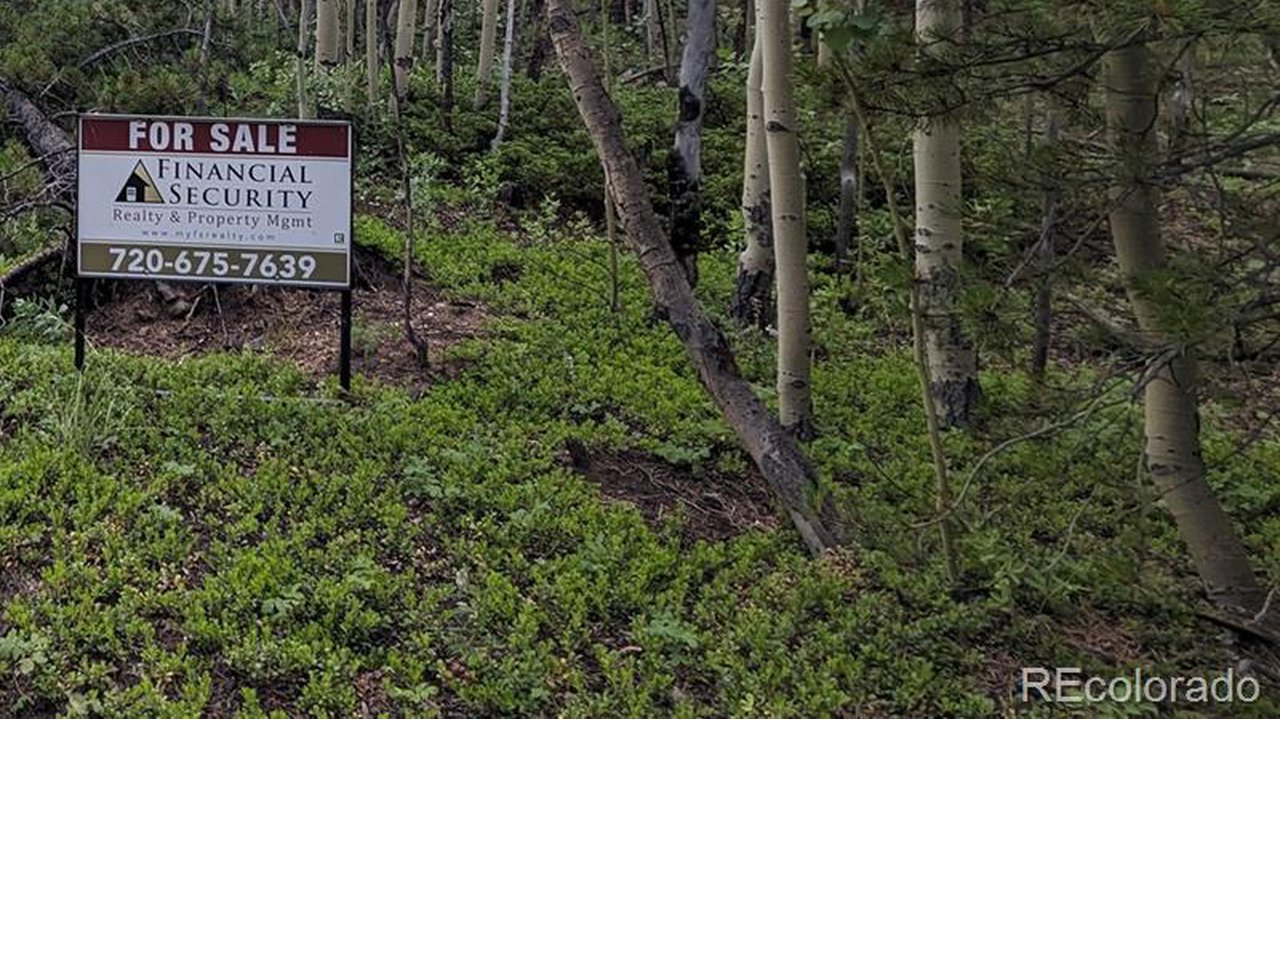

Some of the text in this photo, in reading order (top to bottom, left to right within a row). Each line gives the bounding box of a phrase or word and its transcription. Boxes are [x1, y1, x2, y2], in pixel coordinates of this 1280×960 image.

[129, 121, 297, 153] FOR SALE
[158, 159, 312, 183] FINANCIAL
[169, 183, 312, 208] SECURITY
[113, 208, 312, 230] Realty & Property Mgmt
[109, 248, 316, 279] 720-675-7639
